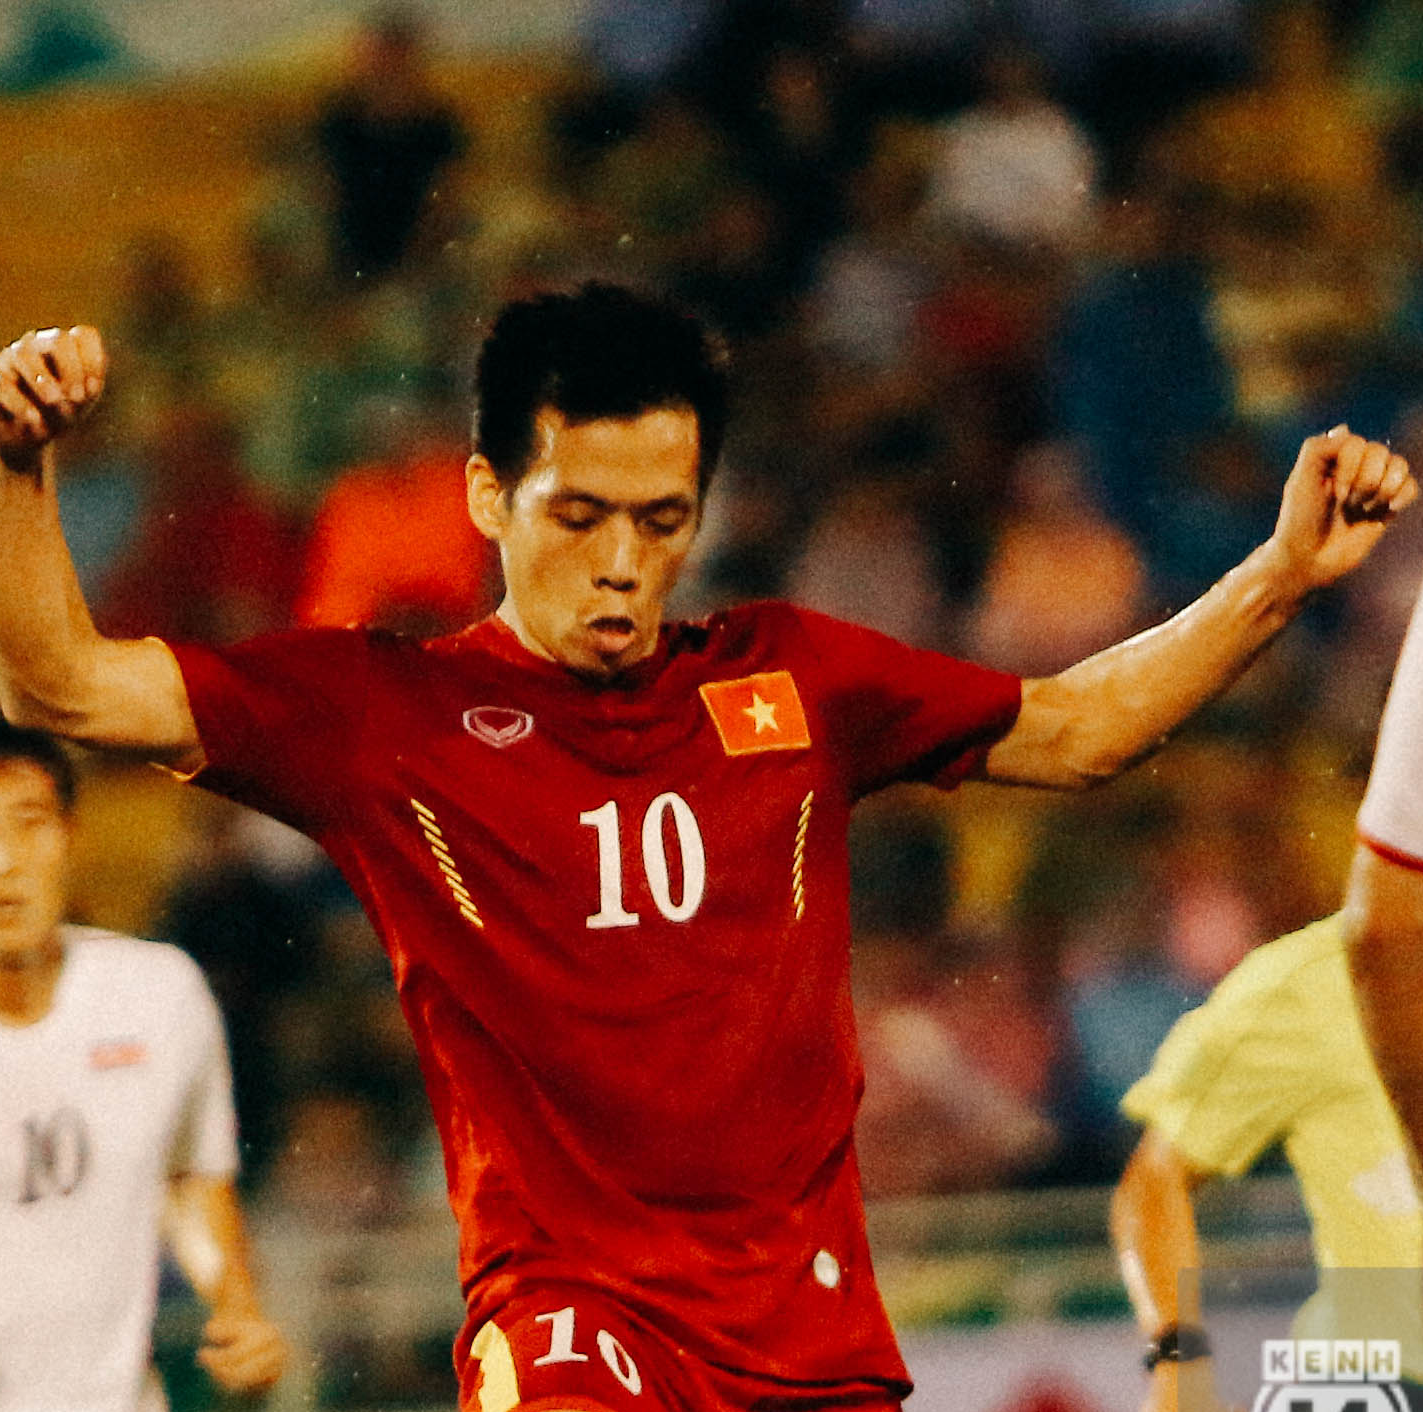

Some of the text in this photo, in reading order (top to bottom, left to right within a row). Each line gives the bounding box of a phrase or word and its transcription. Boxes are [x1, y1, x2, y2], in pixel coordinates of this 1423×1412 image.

[579, 791, 707, 929] 10
[16, 1108, 91, 1206] 10
[533, 1306, 642, 1396] 10
